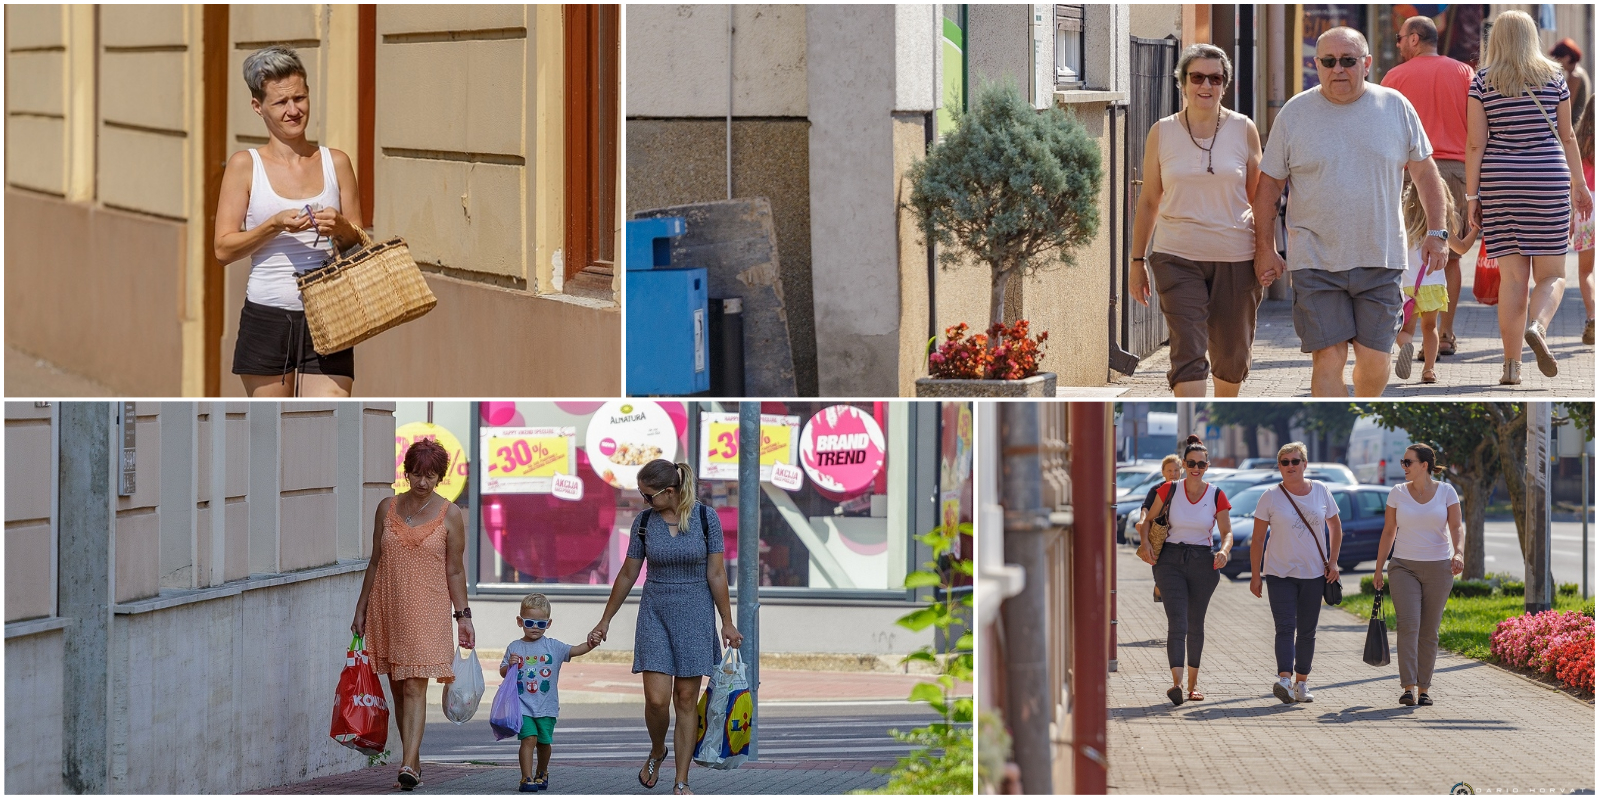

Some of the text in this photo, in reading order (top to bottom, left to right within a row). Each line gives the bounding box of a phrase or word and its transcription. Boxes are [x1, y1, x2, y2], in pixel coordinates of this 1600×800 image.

[610, 412, 646, 424] ALNATURA
[816, 432, 869, 451] BRAND
[488, 439, 549, 473] -30%
[816, 450, 866, 466] TREND
[775, 467, 798, 480] AKCIJA
[555, 478, 578, 490] AKCIJA
